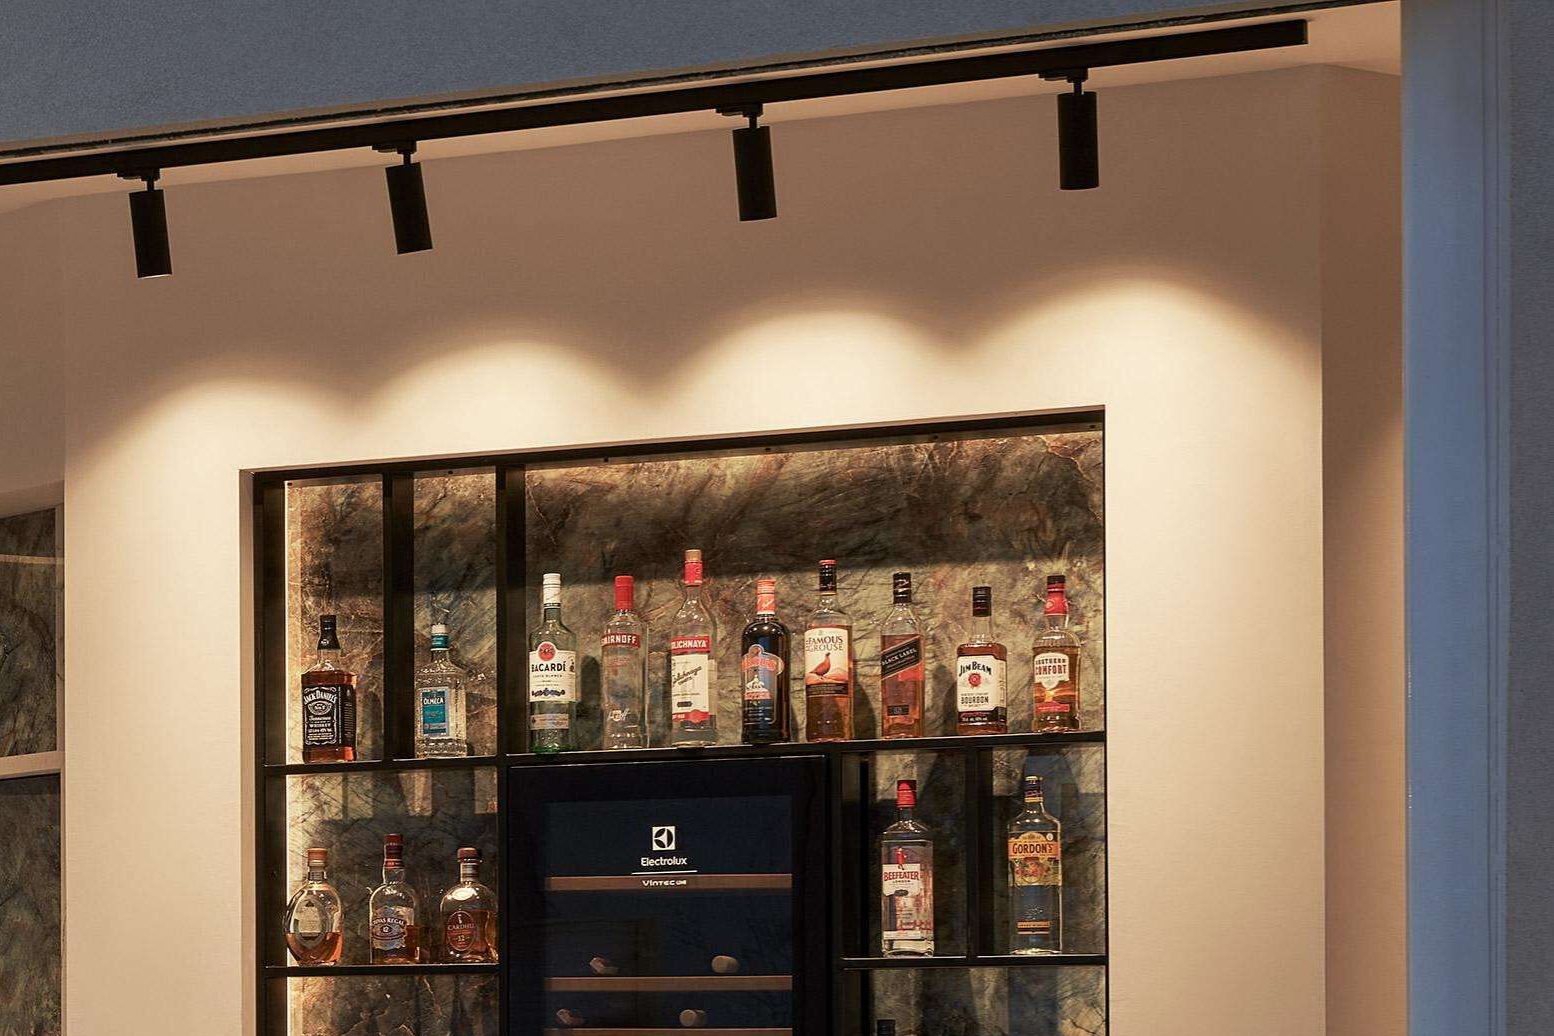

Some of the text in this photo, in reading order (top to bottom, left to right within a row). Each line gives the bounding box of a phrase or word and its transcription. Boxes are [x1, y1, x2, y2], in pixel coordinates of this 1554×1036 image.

[808, 636, 843, 644] FAMOUS
[958, 661, 992, 677] JIM BEAM
[1013, 843, 1053, 854] GORDON'S
[641, 856, 687, 867] Electrolux
[884, 871, 920, 882] BEEFEATER
